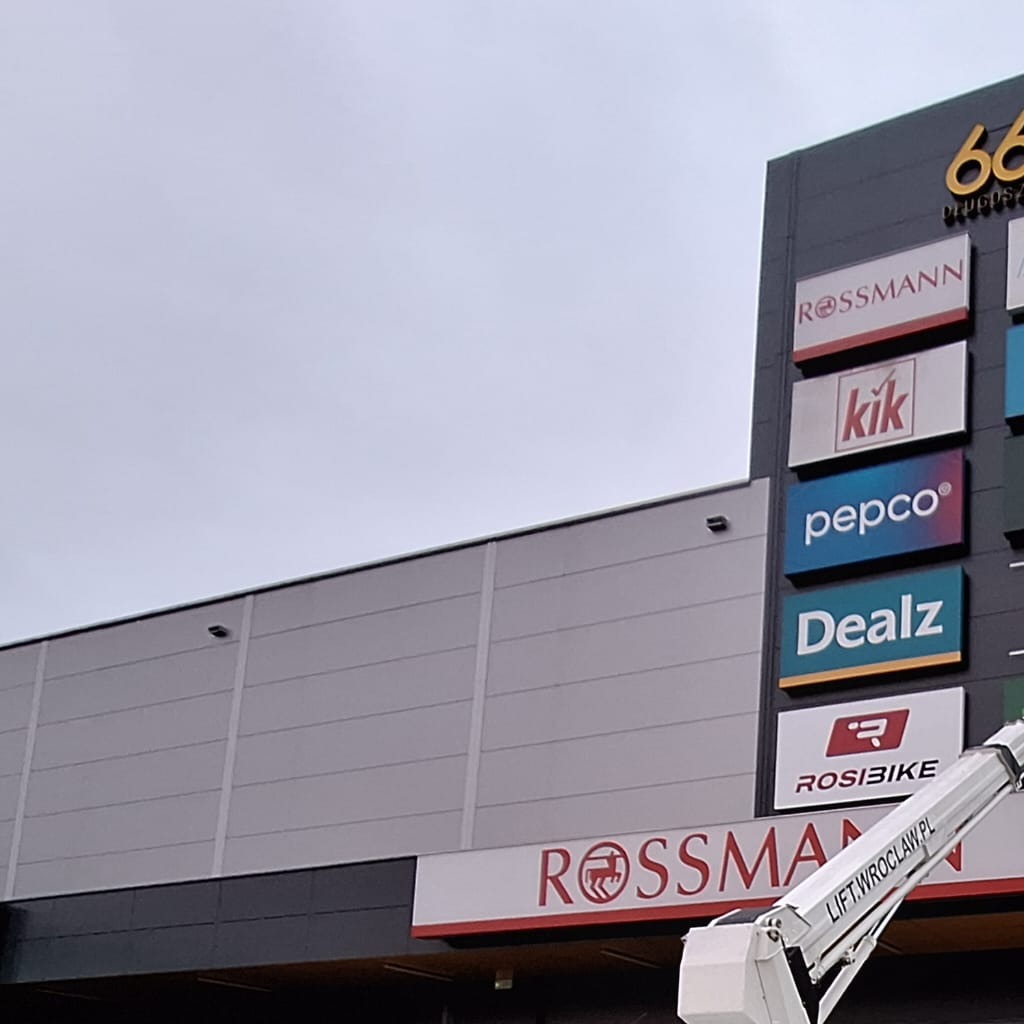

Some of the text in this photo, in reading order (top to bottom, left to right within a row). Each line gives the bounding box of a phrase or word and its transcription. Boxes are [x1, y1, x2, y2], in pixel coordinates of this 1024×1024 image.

[798, 259, 964, 325] ROSSMANN
[797, 593, 944, 656] Dealz
[795, 760, 939, 793] ROSIBIKE
[538, 817, 962, 907] ROSSMA
[825, 817, 936, 924] LIFT.WROCLAW.PL
